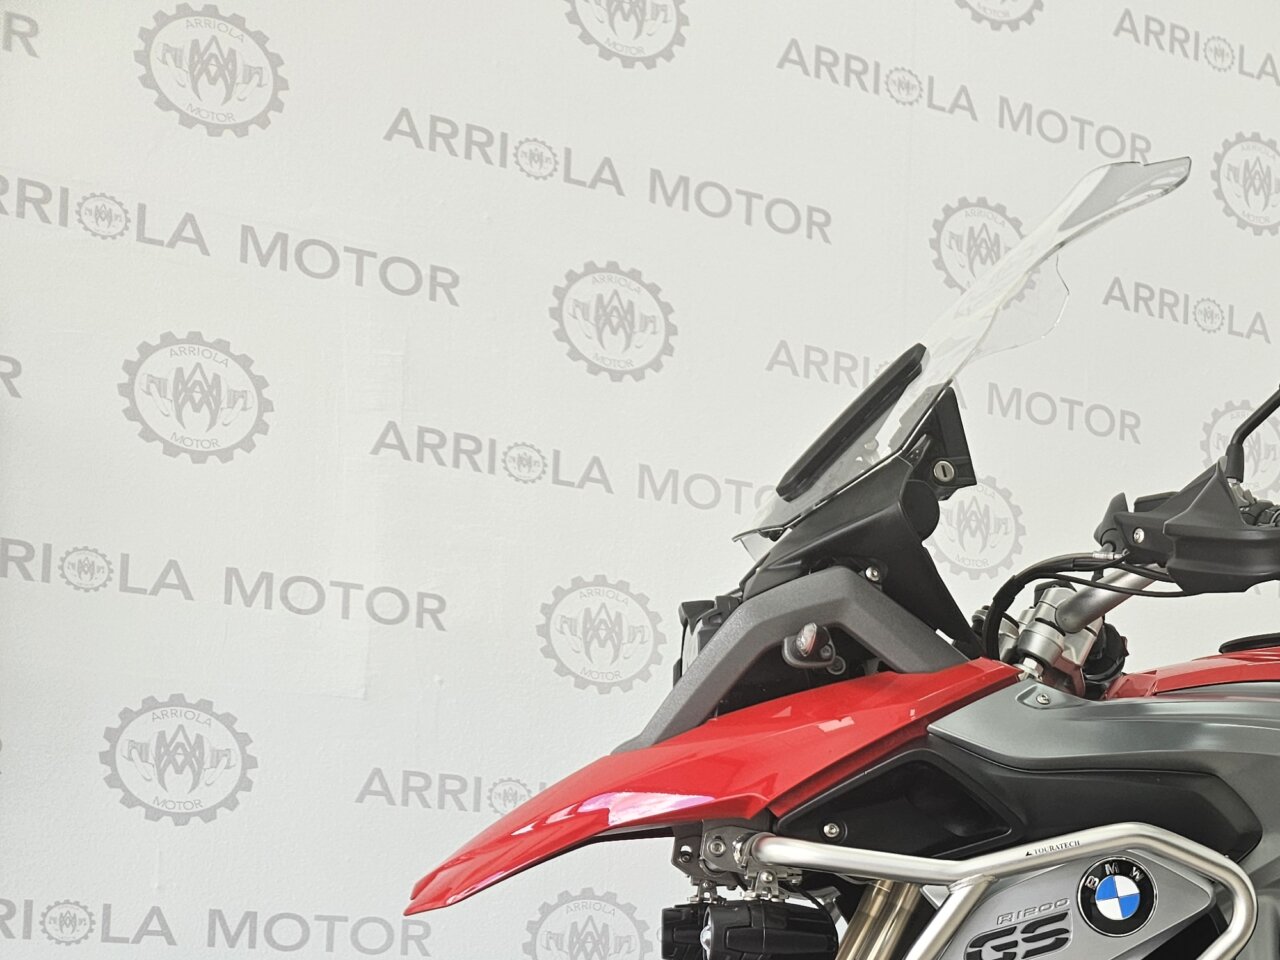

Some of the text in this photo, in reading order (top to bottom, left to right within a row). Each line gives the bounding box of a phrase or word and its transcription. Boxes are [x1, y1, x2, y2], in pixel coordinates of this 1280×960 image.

[185, 20, 245, 42] ARRIOLA
[605, 37, 647, 56] MOTOR
[186, 103, 236, 122] MOTOR
[998, 95, 1152, 163] MOTOR
[648, 168, 832, 245] MOTOR
[0, 174, 460, 307] RIOLA MOTOR
[169, 346, 229, 368] ARRIOLA
[987, 382, 1141, 445] MOTOR
[170, 432, 220, 449] MOTOR
[0, 536, 447, 632] RIOLA MOTOR
[579, 587, 630, 606] ARRIOLA
[580, 666, 623, 681] MOTOR
[151, 708, 212, 728] ARRIOLA
[152, 796, 203, 811] MOTOR
[1034, 840, 1081, 855] TOURATECH
[1085, 862, 1144, 890] BMW
[564, 901, 616, 917] ARRIOLA
[997, 897, 1070, 925] R1200
[206, 908, 432, 957] MOTOR
